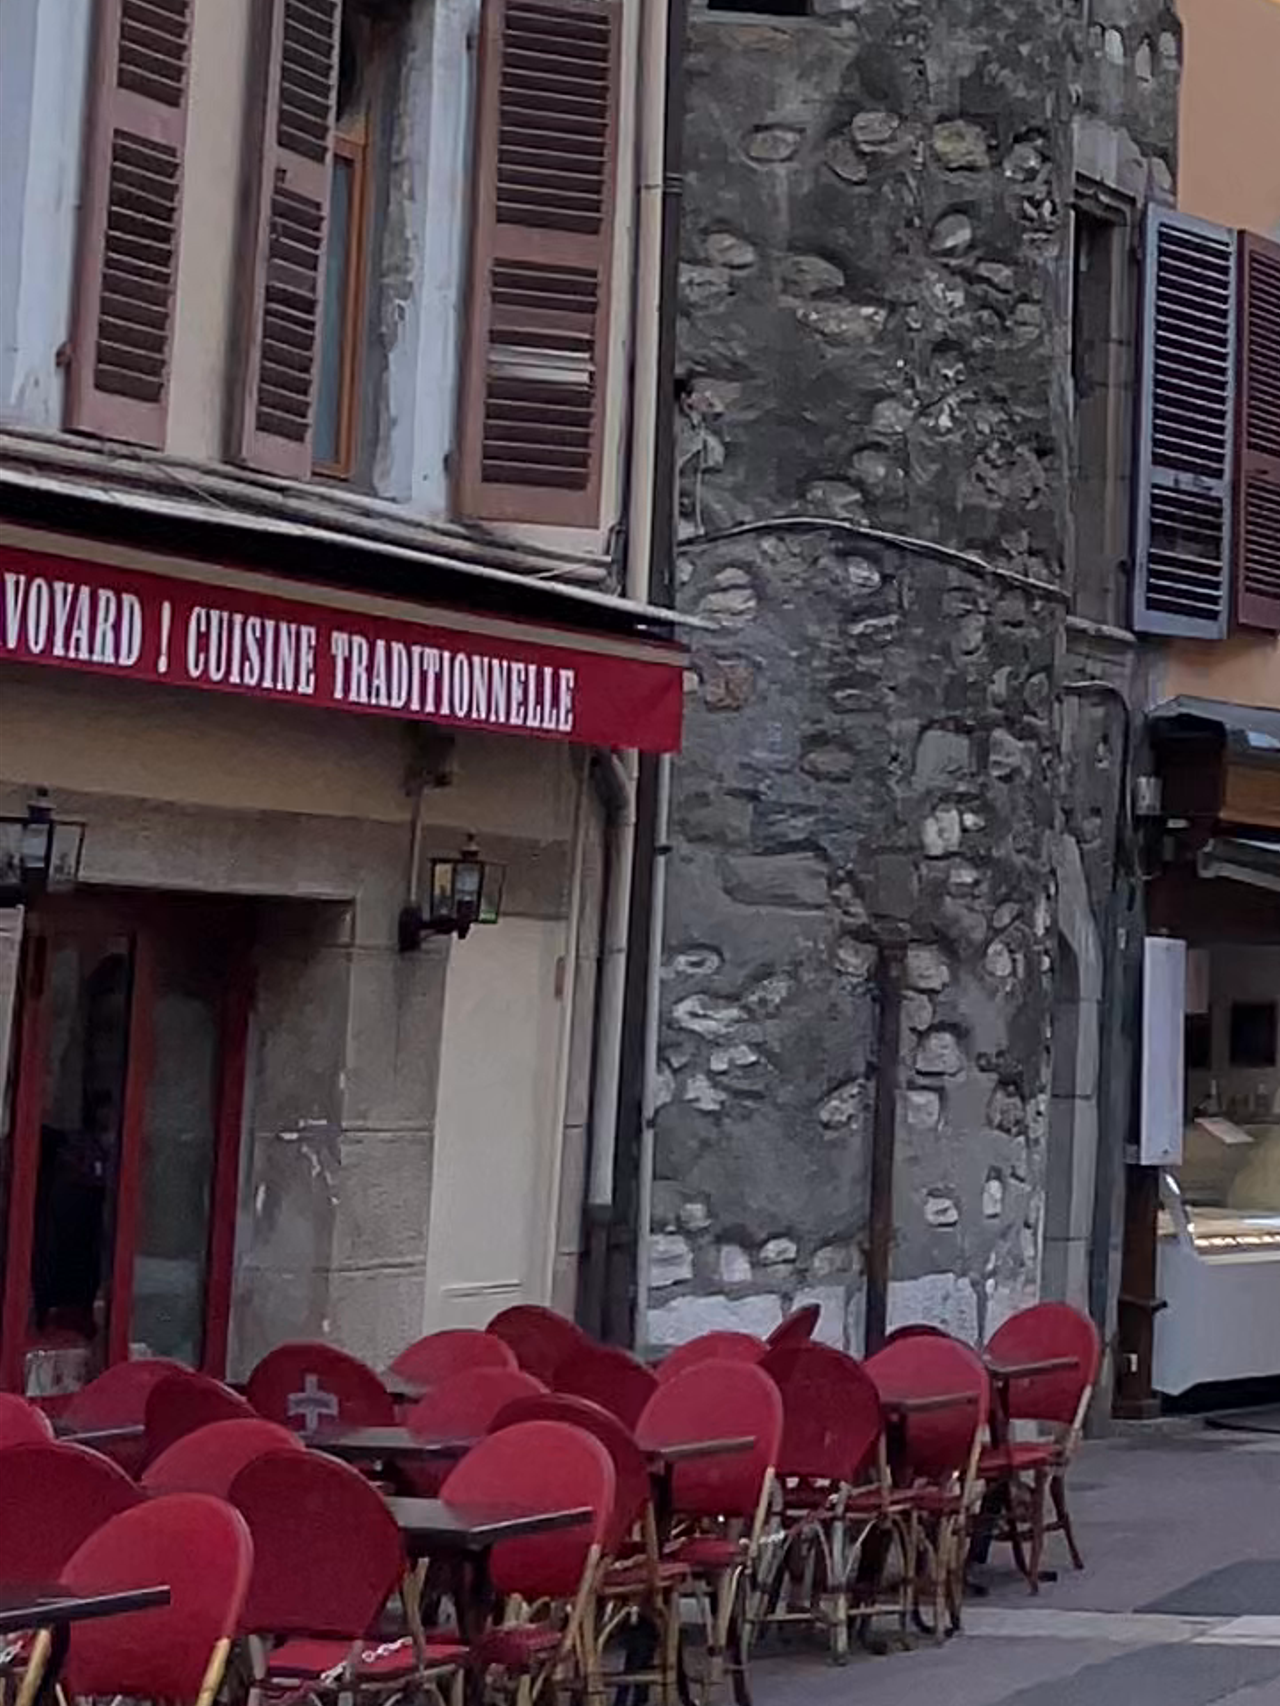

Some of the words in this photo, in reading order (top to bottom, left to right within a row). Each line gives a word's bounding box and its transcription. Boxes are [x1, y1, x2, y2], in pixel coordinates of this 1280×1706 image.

[0, 572, 143, 667] VOYARD
[187, 606, 316, 694] CUISINE
[331, 631, 576, 733] TRADITIONNELLE
